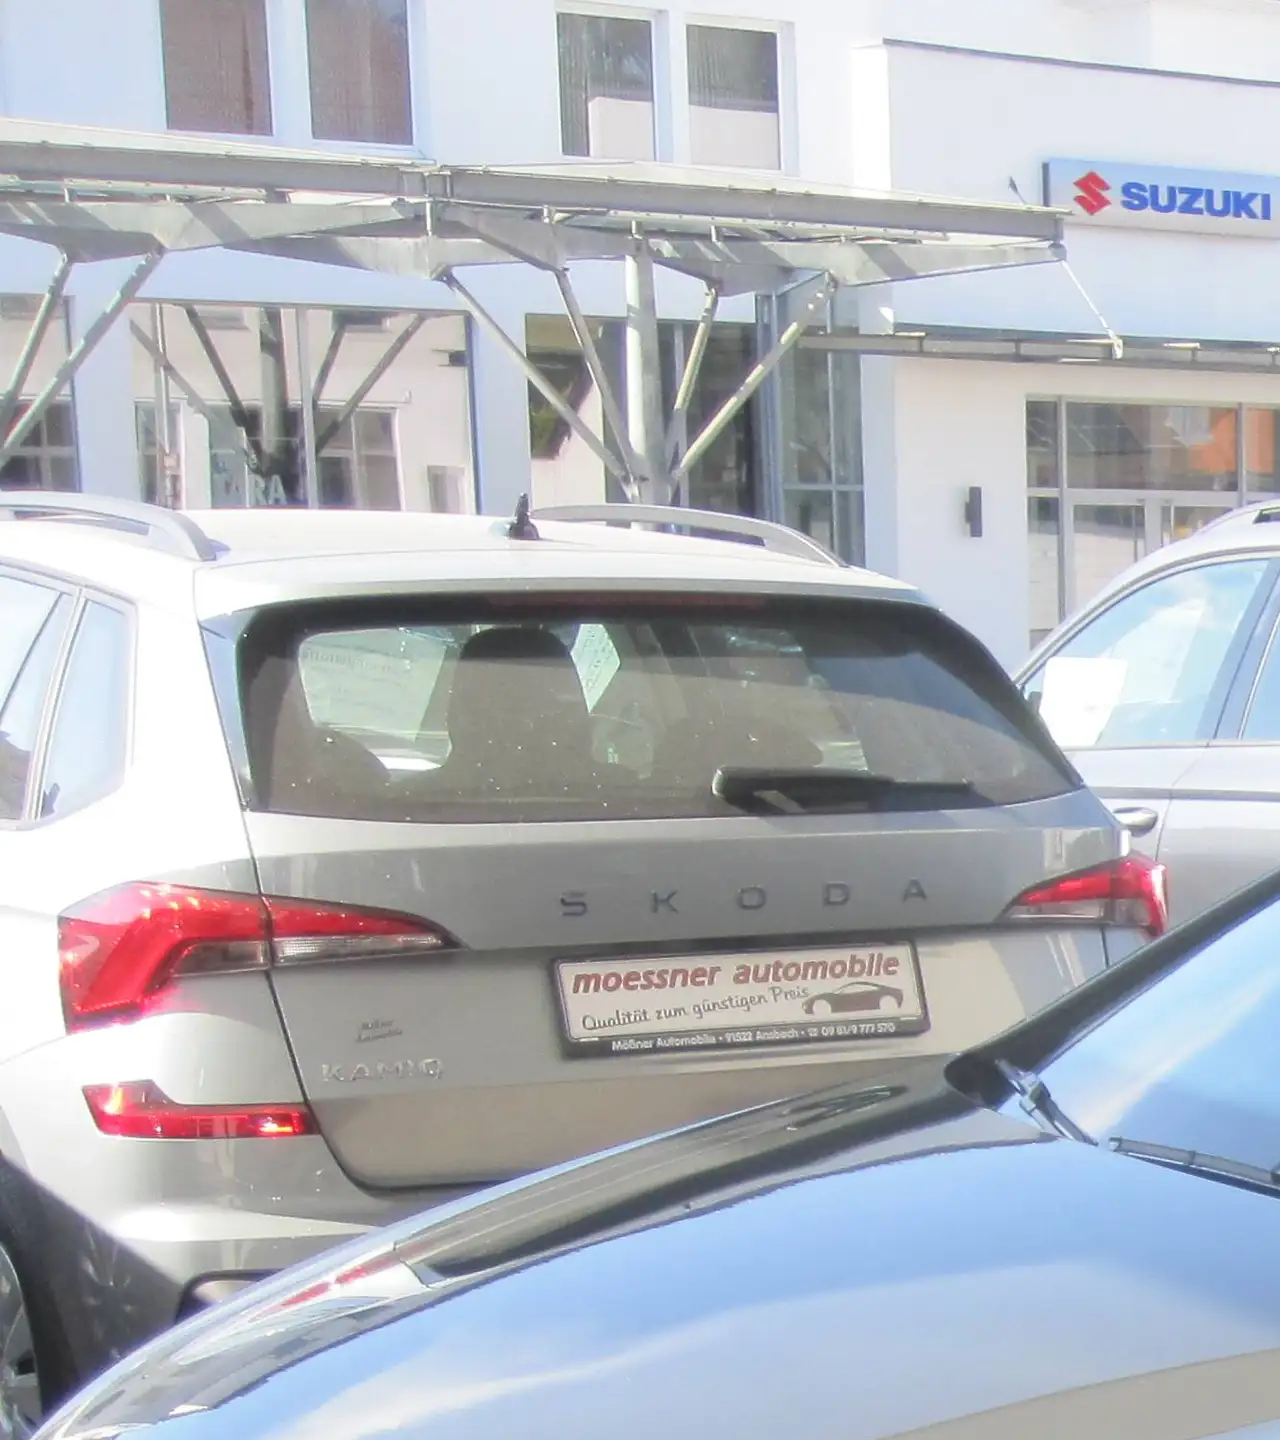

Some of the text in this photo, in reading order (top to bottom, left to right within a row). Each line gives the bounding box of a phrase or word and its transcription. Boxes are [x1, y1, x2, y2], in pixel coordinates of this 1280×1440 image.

[1121, 182, 1271, 220] SUZUKI
[572, 952, 900, 994] moessner automobile
[582, 987, 810, 1031] Qualität zum günstigen Preis
[656, 1033, 716, 1048] Automobile
[755, 1028, 799, 1041] Ansbach
[322, 1058, 443, 1082] KAMIQ
